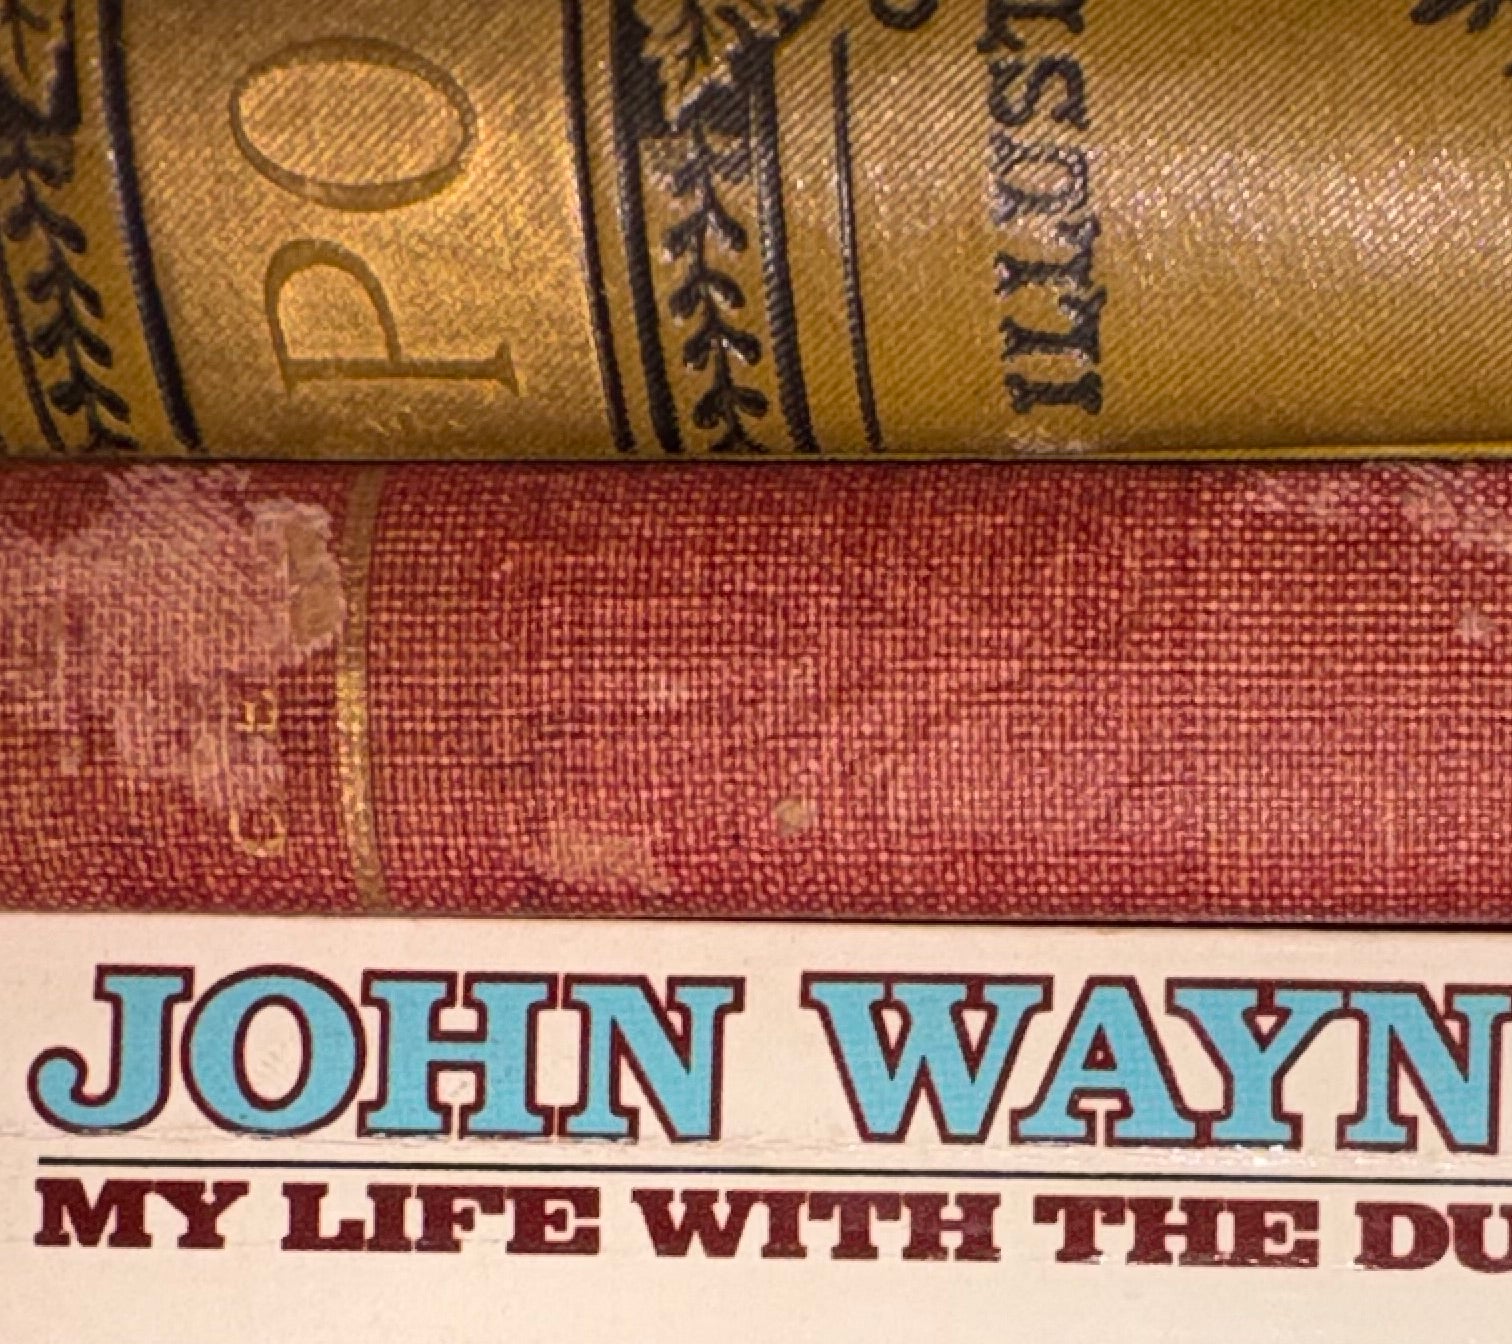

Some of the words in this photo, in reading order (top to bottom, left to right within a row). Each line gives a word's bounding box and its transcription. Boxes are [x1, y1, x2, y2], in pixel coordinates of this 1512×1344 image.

[27, 964, 746, 1143] JOHN
[34, 1178, 249, 1248] MY
[281, 1183, 601, 1254] LIFE
[631, 1188, 1001, 1261] WITH
[1033, 1195, 1320, 1268] THE
